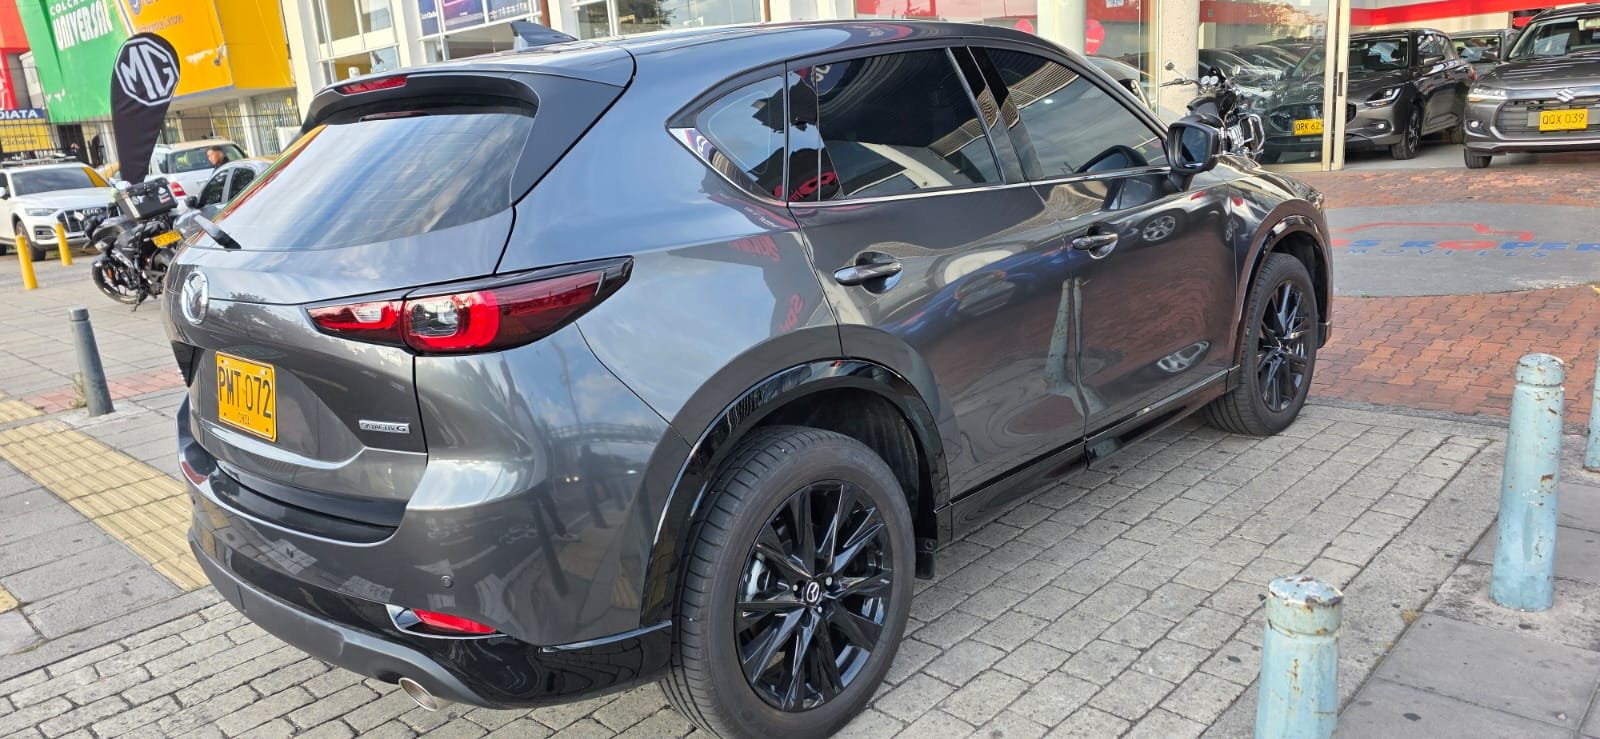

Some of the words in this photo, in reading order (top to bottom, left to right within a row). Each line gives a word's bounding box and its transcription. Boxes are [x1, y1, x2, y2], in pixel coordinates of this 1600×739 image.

[120, 44, 177, 100] MG
[218, 366, 241, 408] PMT
[246, 374, 272, 419] 072
